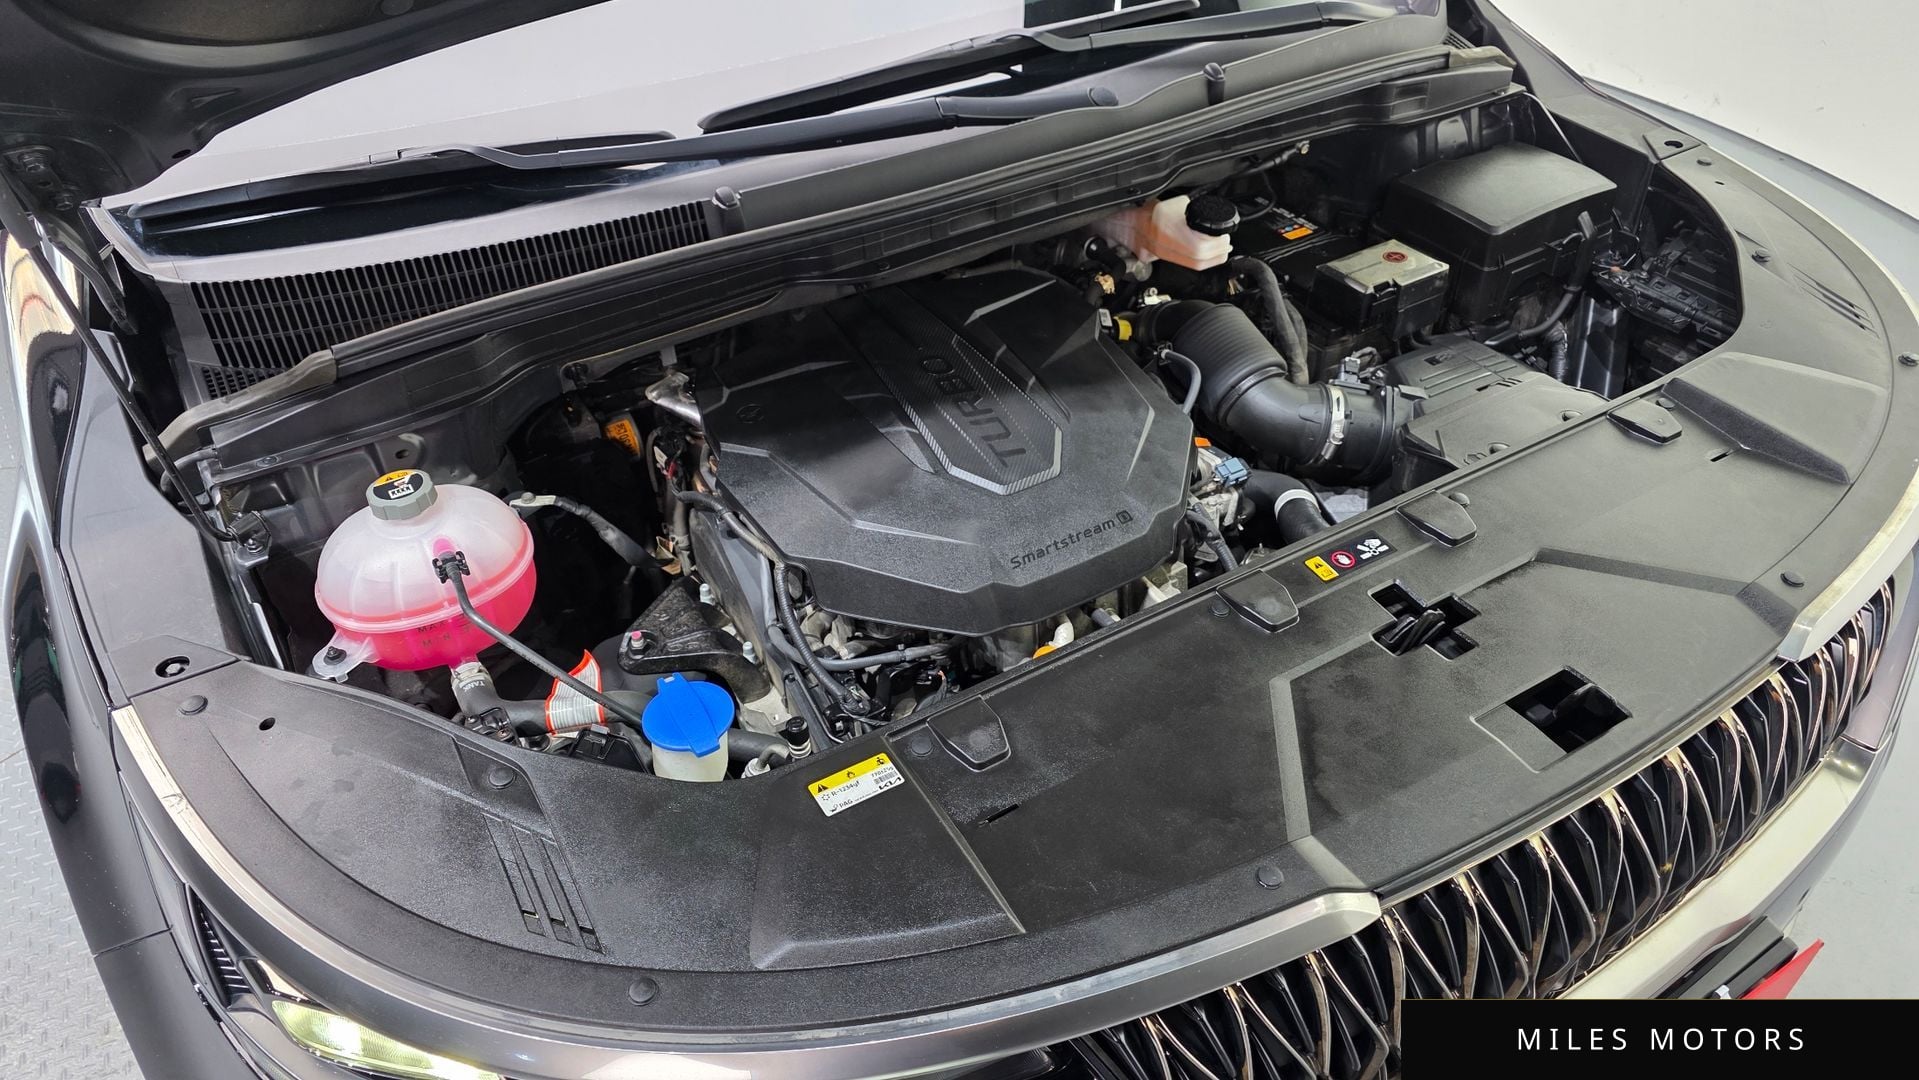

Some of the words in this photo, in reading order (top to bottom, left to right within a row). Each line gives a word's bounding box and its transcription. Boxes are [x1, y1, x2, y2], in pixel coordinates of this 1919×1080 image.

[920, 358, 1026, 468] TURBO
[1010, 519, 1115, 570] Smartstream
[463, 680, 485, 692] TANK
[831, 781, 860, 796] R-1234yf
[878, 777, 902, 790] KIA
[839, 800, 853, 808] PAG
